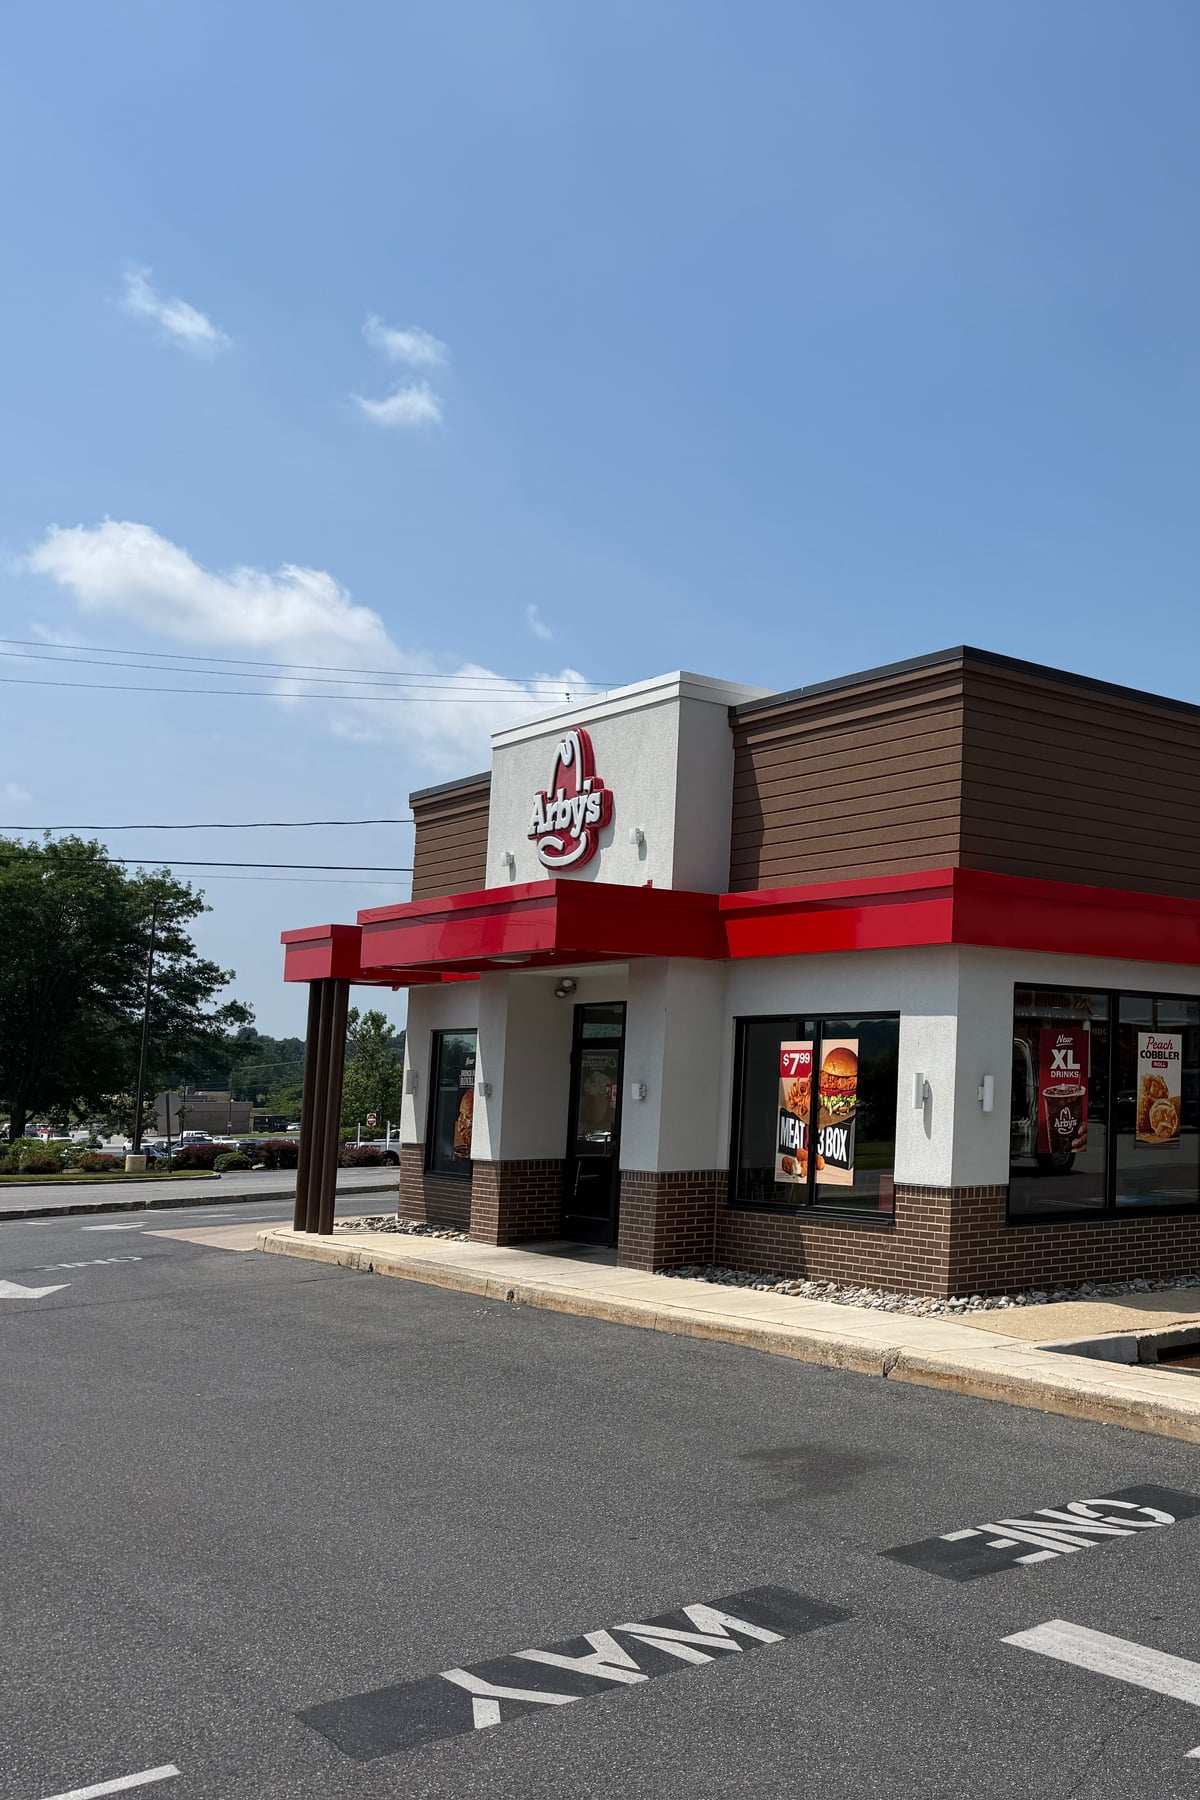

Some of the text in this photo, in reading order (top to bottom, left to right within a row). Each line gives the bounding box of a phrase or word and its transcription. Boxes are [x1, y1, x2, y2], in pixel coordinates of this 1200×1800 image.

[528, 780, 602, 838] Arby's
[1057, 1034, 1073, 1045] New
[1145, 1036, 1174, 1050] Peach
[1050, 1049, 1080, 1069] XL
[1140, 1050, 1180, 1060] COBBLER
[1054, 1116, 1078, 1129] Arby's
[780, 1115, 805, 1150] MEAT
[825, 1126, 847, 1162] BOX
[939, 1498, 1176, 1564] ONE
[439, 1602, 788, 1729] WAY
